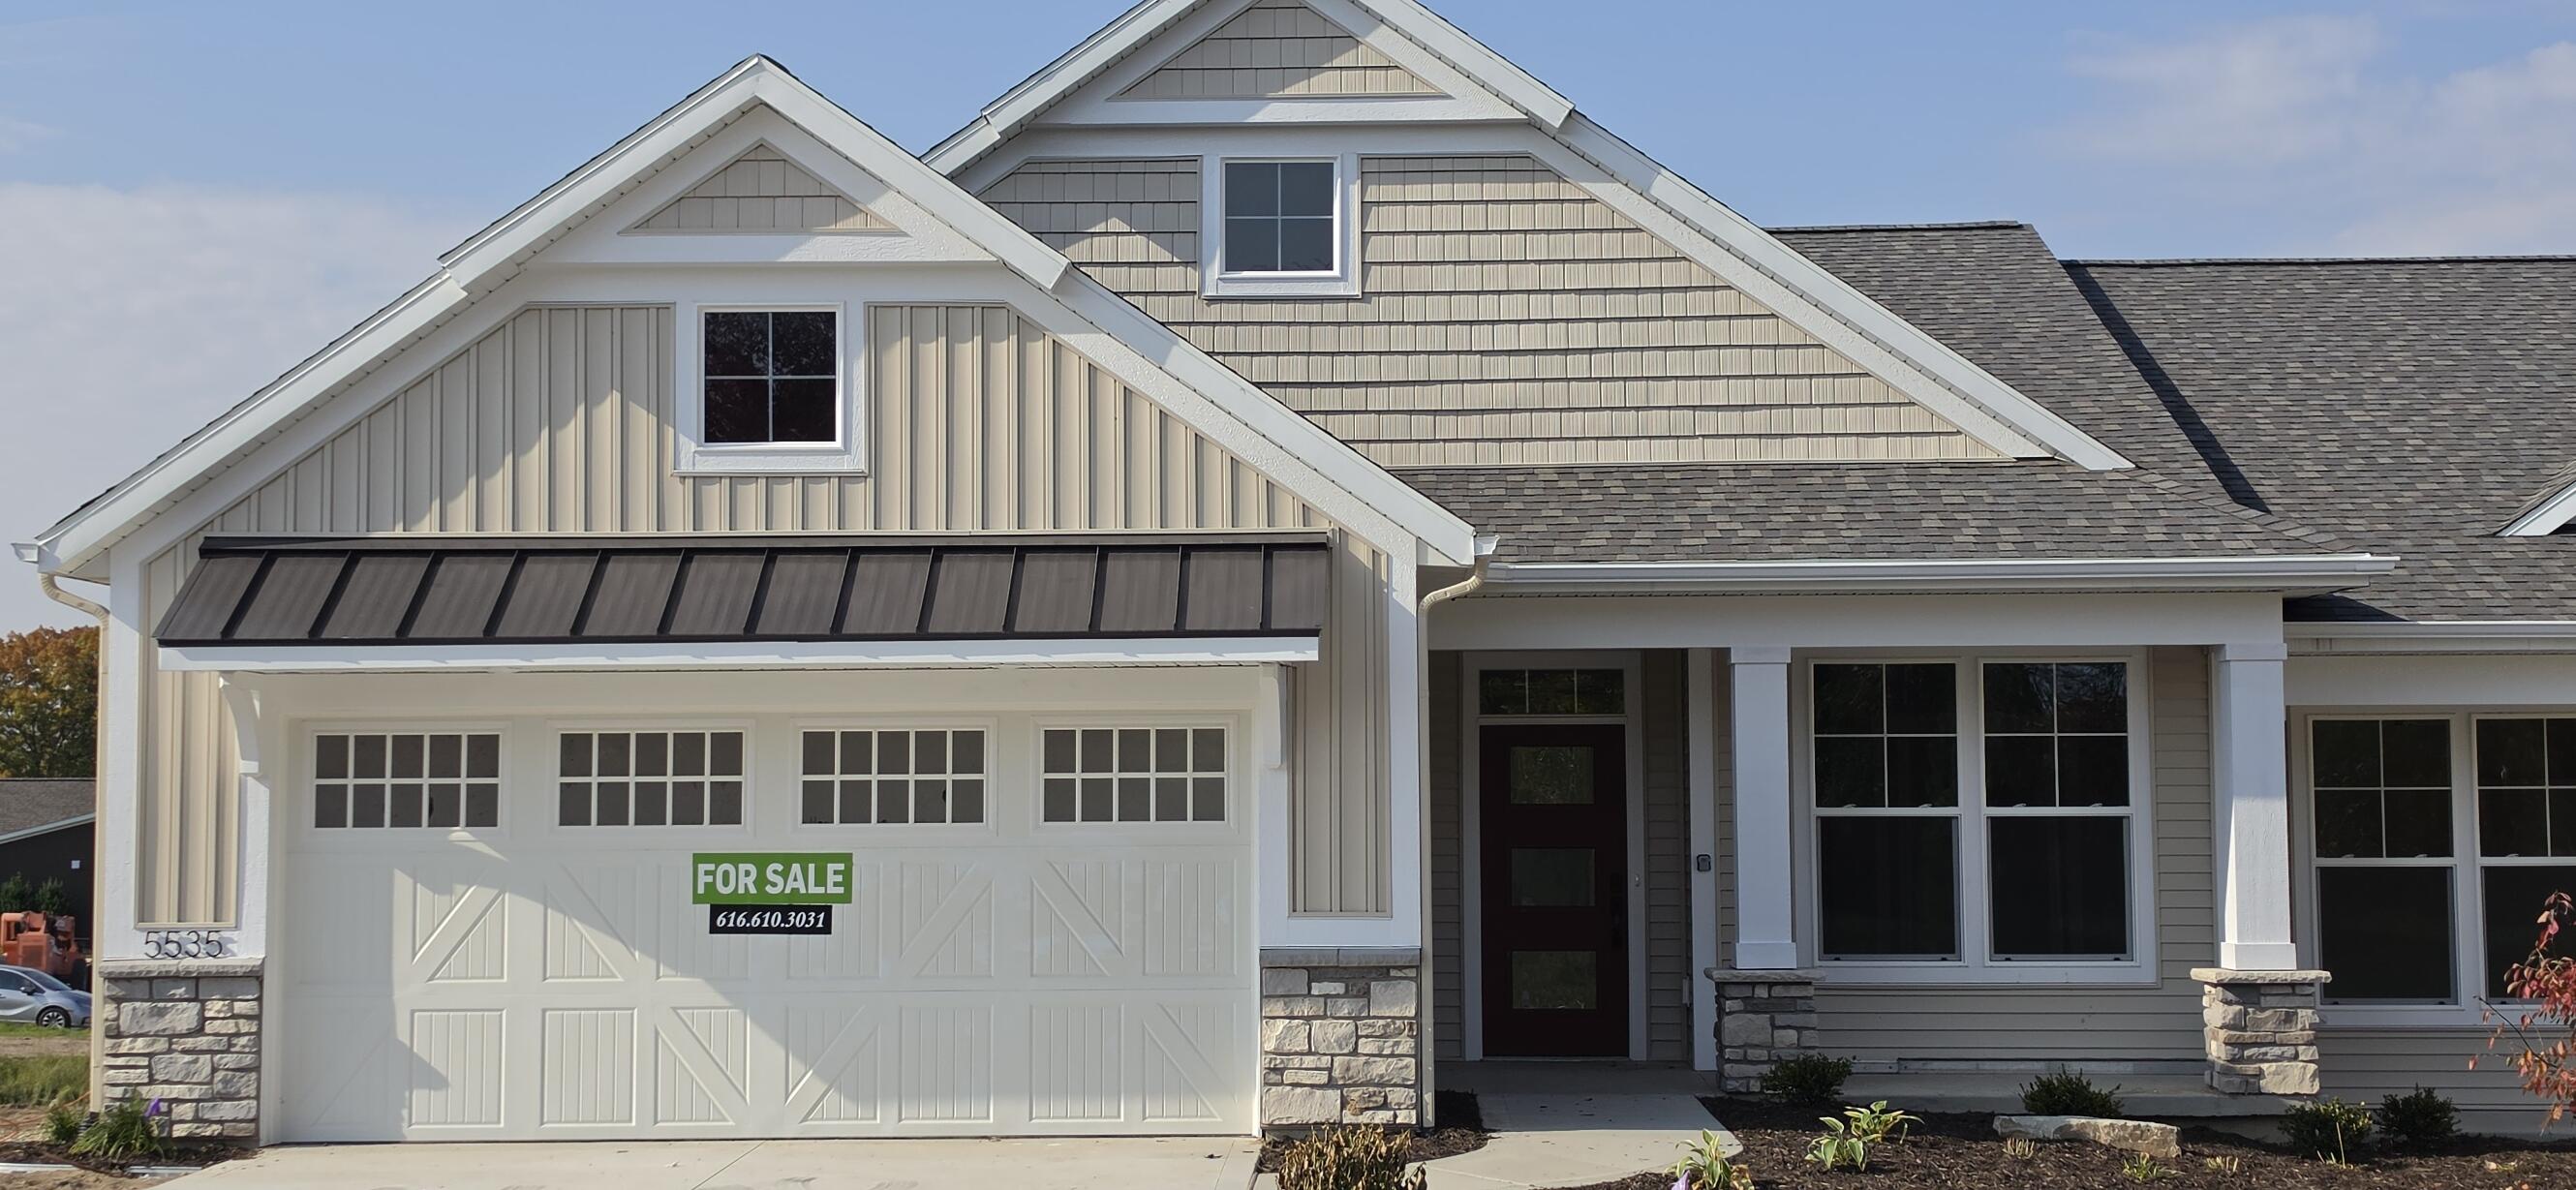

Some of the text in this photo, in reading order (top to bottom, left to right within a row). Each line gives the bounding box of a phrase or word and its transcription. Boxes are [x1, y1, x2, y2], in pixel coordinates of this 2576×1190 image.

[697, 863, 845, 895] FOR SALE
[716, 911, 825, 929] 616.610.3031
[144, 931, 223, 959] 5535
